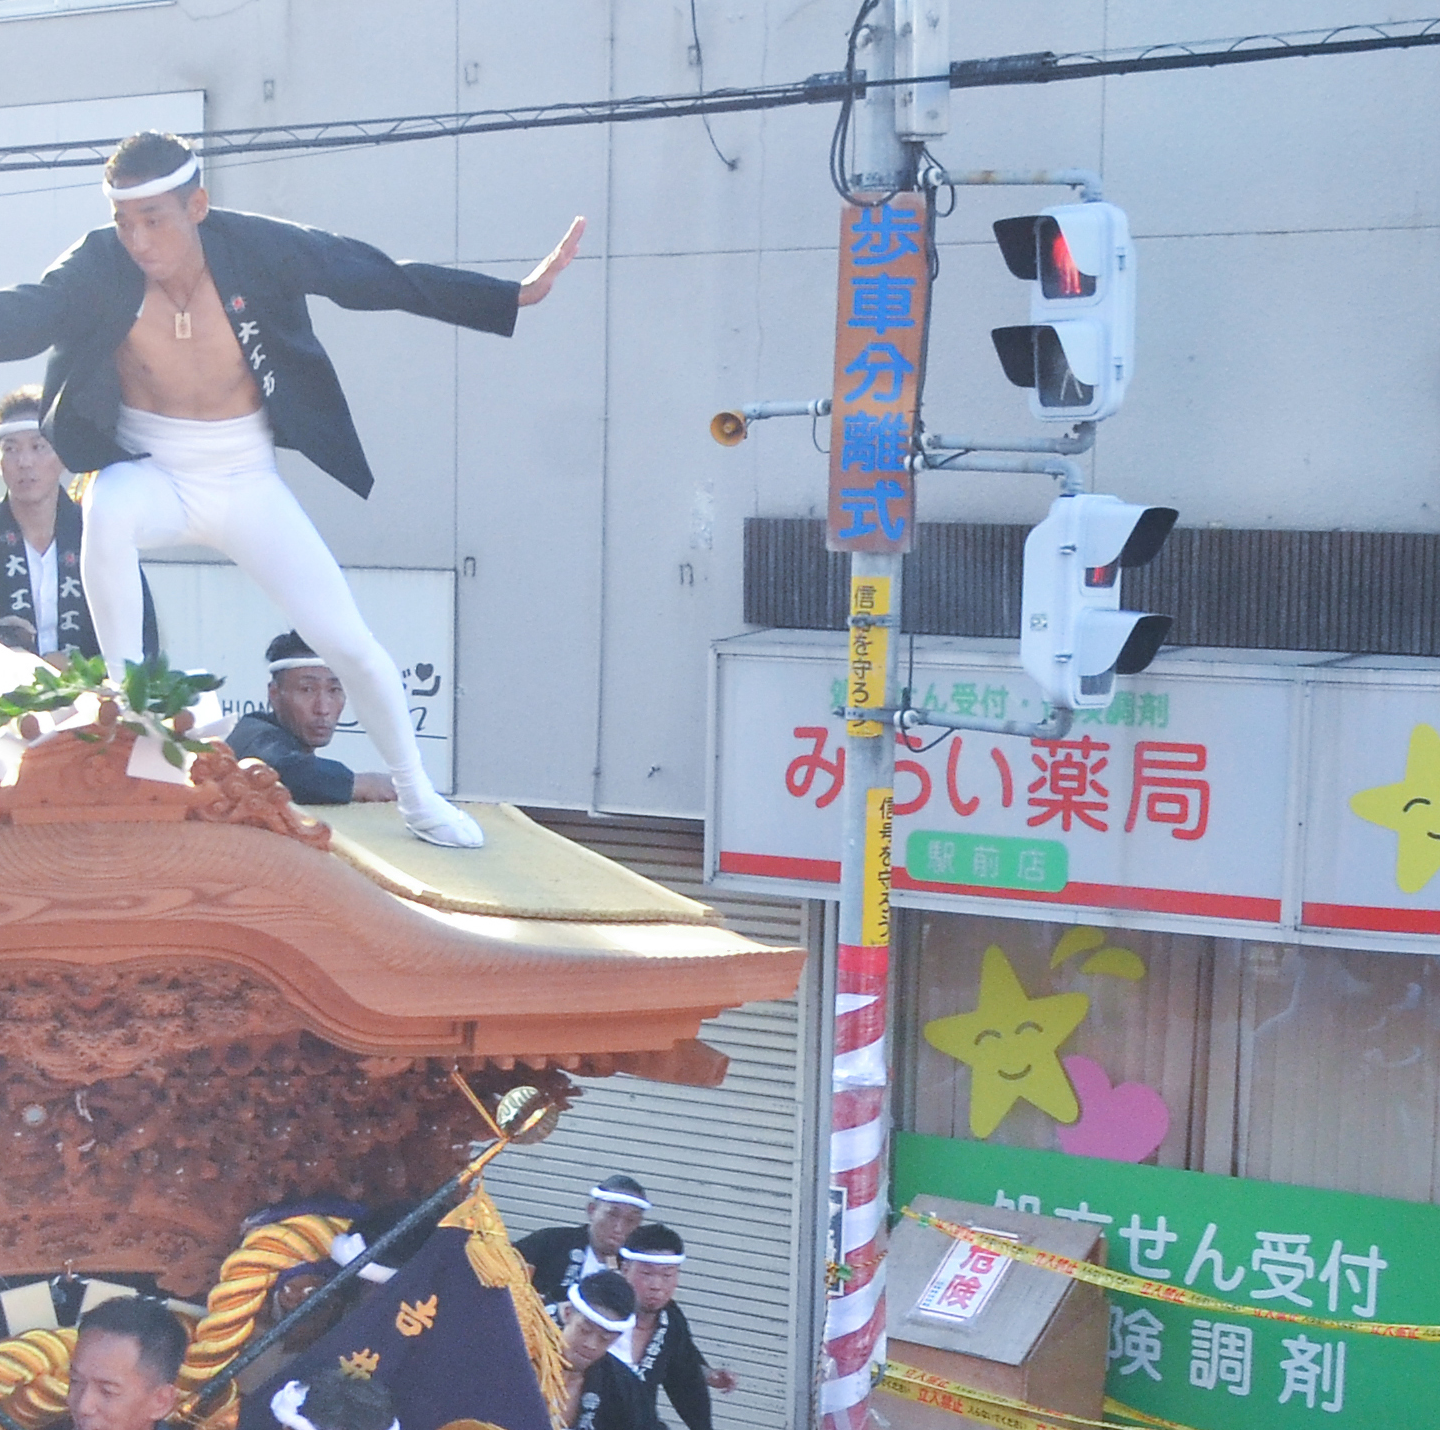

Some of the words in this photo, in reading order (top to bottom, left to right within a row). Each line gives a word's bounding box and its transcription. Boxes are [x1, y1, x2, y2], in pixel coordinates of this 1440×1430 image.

[838, 204, 921, 542] 歩車分離式
[926, 840, 1046, 883] 駅前店
[994, 1189, 1388, 1318] せん受付
[917, 1385, 964, 1415] 立入禁止
